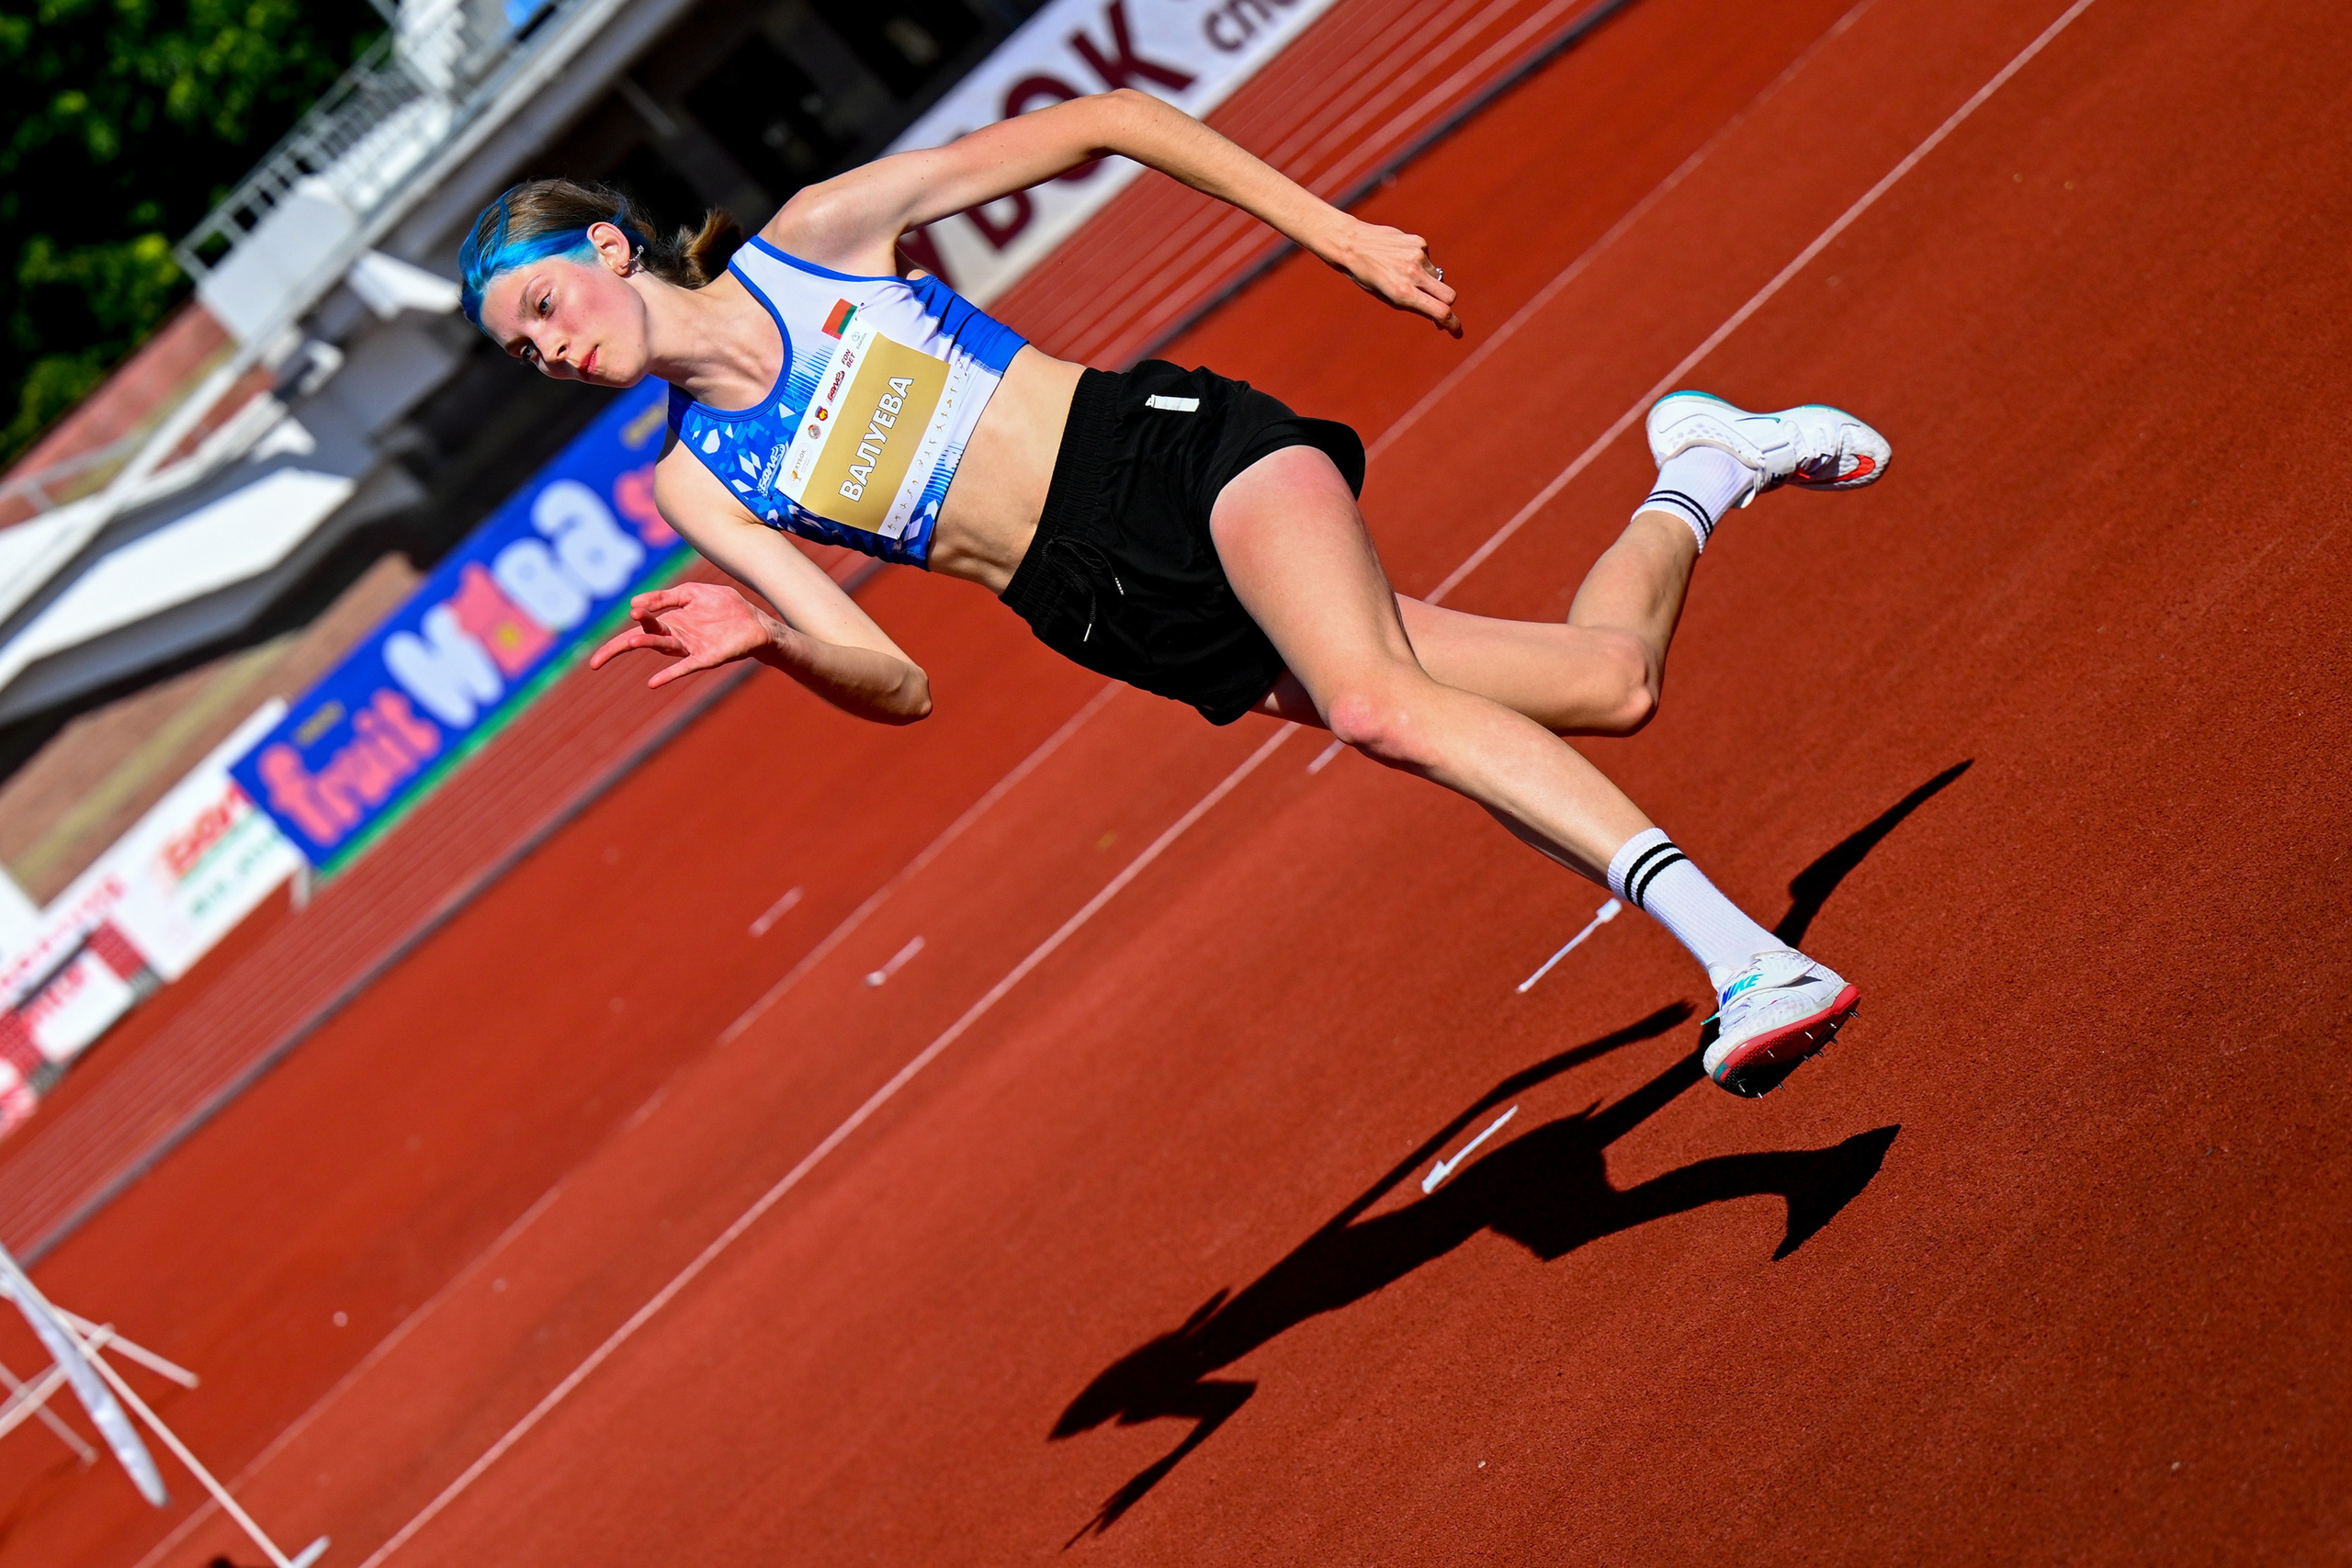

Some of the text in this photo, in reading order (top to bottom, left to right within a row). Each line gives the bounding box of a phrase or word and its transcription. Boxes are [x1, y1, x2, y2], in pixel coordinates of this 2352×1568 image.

[842, 349, 851, 365] FON
[846, 353, 855, 368] BET
[838, 375, 914, 502] ВАЛУЕВА
[258, 689, 440, 845] fruit
[1721, 974, 1764, 1010] NIKE
